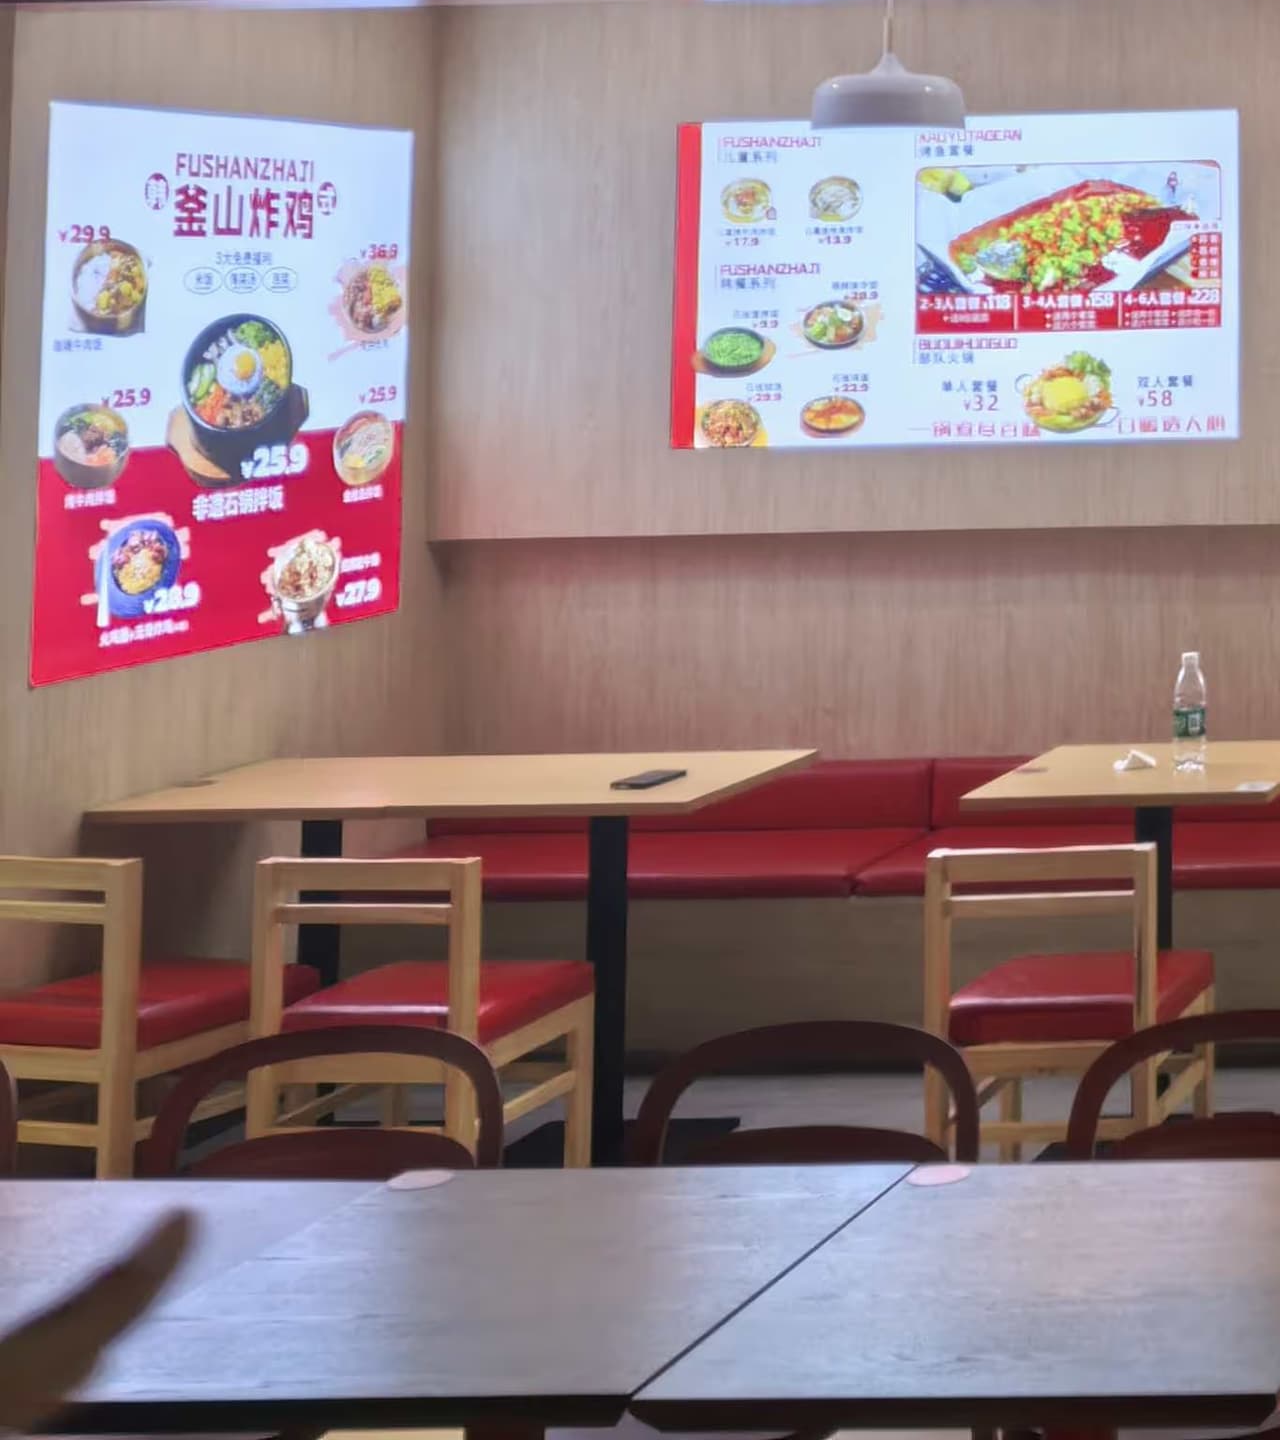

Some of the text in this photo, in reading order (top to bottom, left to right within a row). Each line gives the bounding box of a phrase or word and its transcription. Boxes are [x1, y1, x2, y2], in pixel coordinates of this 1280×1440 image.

[175, 152, 315, 183] FUSHANZHAJI
[173, 184, 313, 240] 釜山炸鸡
